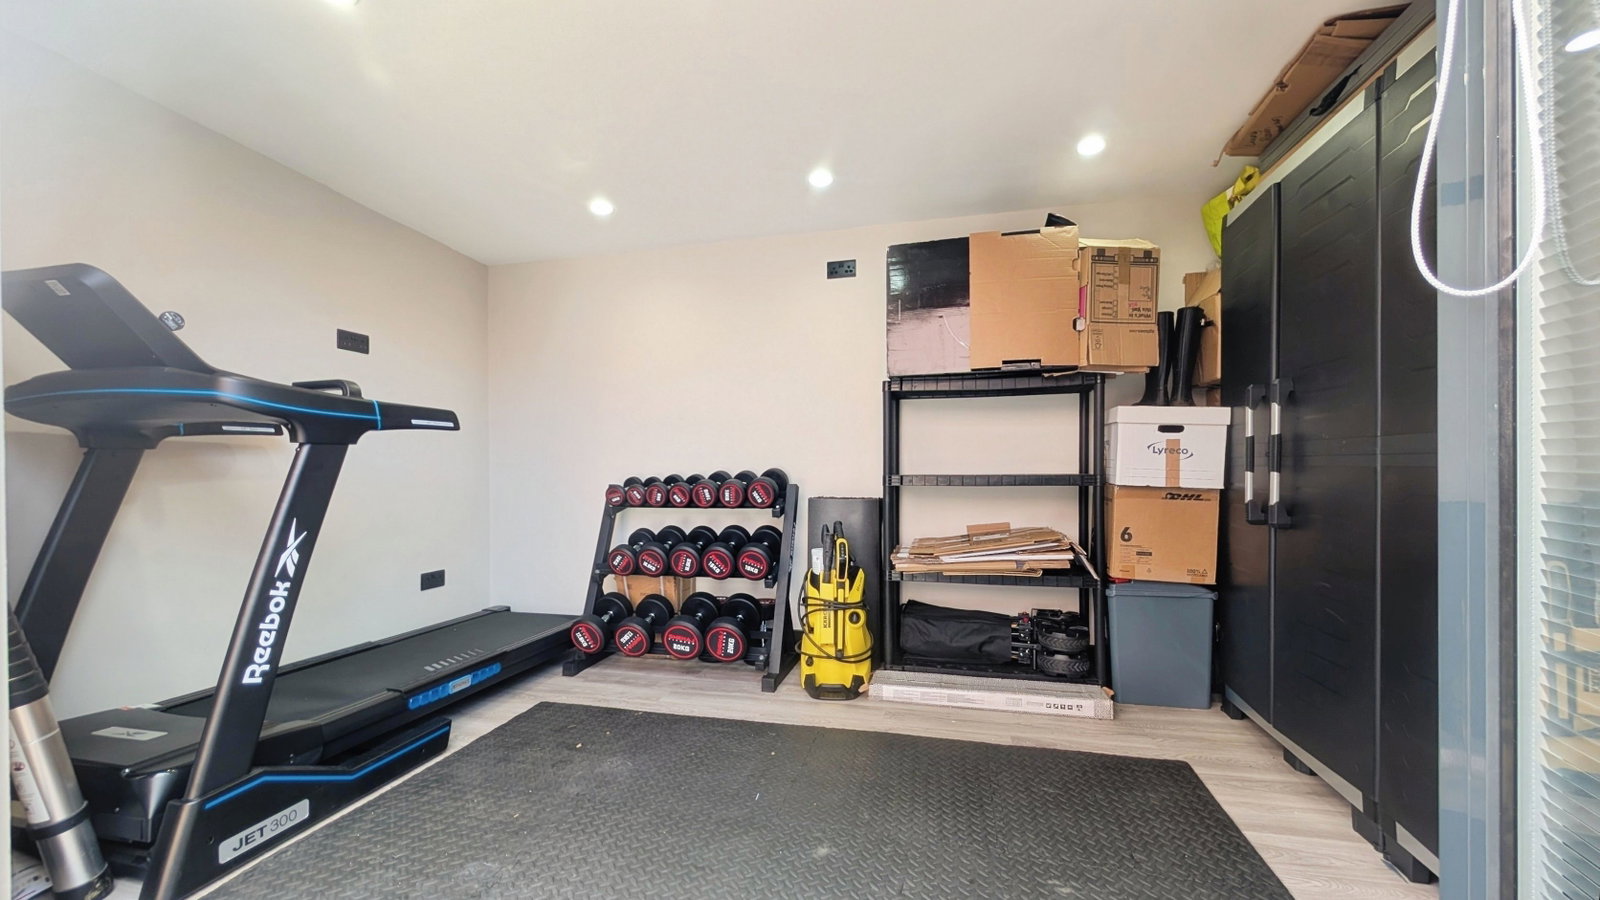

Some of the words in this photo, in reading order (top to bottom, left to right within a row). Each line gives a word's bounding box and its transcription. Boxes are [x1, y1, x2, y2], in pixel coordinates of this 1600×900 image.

[1152, 446, 1189, 456] Lyreco
[1167, 493, 1206, 501] DHL
[1120, 526, 1133, 542] 6
[242, 580, 292, 685] Reebok
[232, 823, 268, 853] JET
[270, 808, 298, 832] 300
